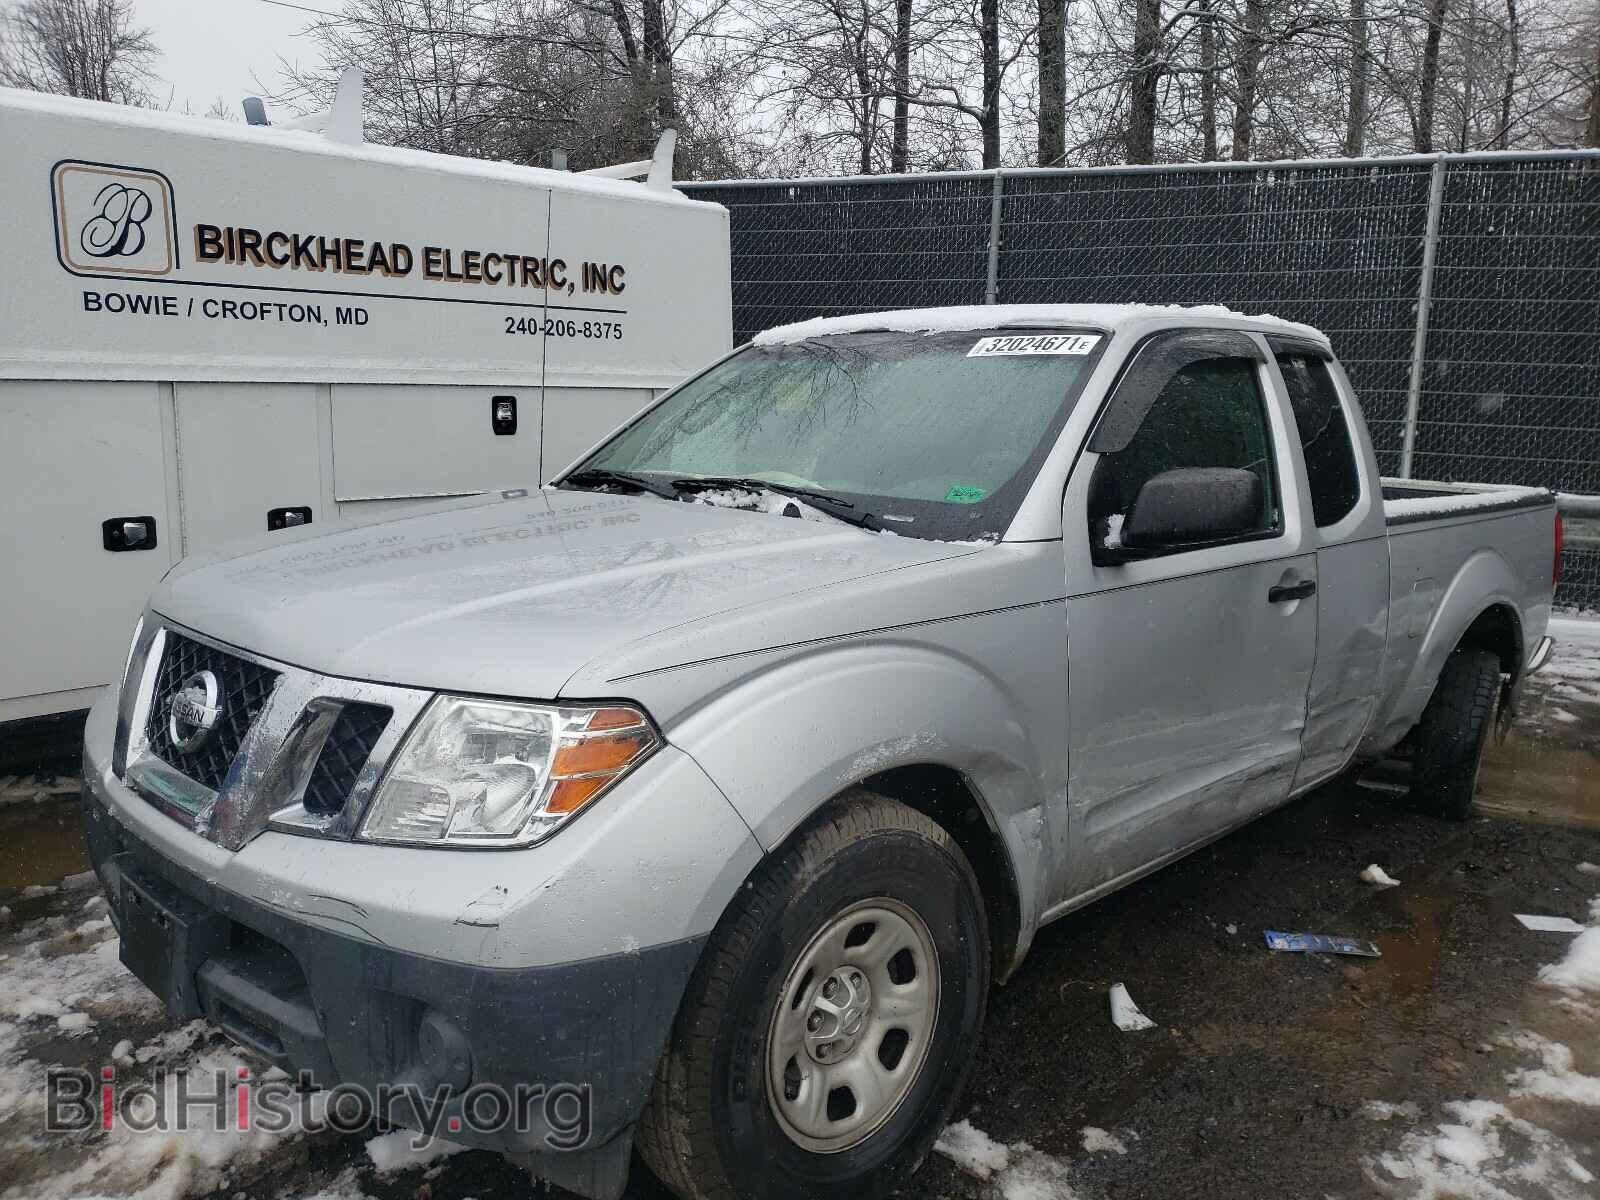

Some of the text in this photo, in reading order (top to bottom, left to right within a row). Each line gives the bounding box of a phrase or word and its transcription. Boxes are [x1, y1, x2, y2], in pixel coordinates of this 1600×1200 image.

[193, 223, 626, 296] BIRCKHEAD ELECTRIC, INC
[83, 291, 178, 316] BOWIE
[202, 299, 328, 327] CROFTON,
[336, 307, 369, 325] MD
[505, 317, 623, 339] 240-206-8375
